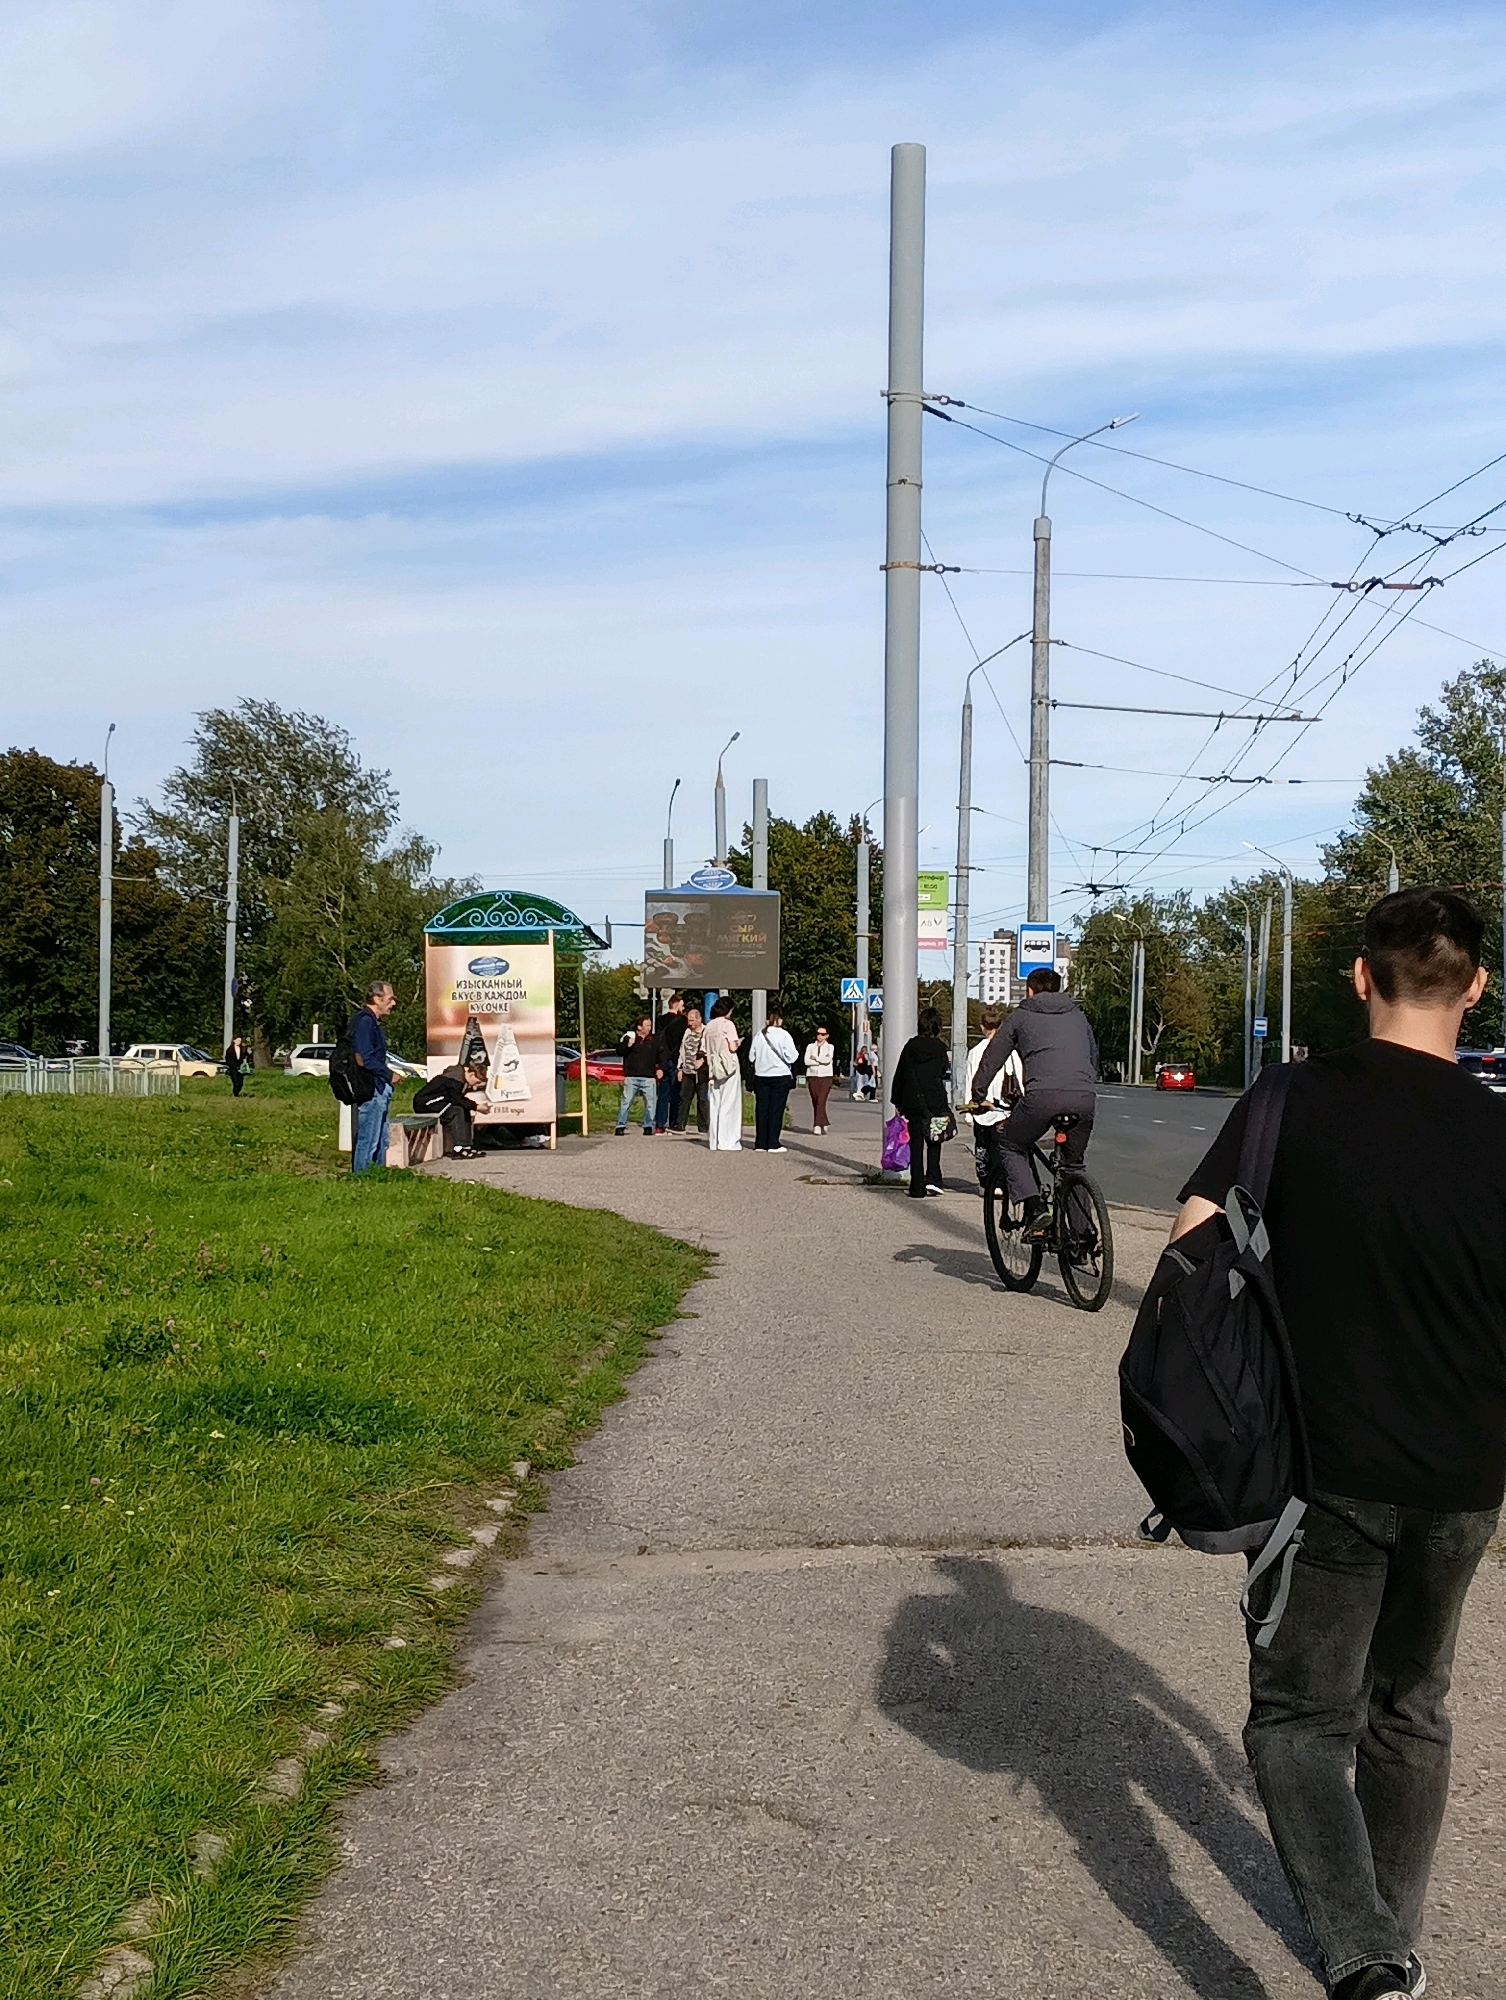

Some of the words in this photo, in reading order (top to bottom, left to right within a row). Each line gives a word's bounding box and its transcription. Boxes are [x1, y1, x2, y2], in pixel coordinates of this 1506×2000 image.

[456, 978, 523, 989] ИЗЫСКАННЫЙ
[451, 991, 475, 1001] ВКУС
[476, 991, 482, 1000] В
[484, 990, 528, 1000] КАЖДОМ
[470, 1002, 509, 1012] КУСОЧКЕ
